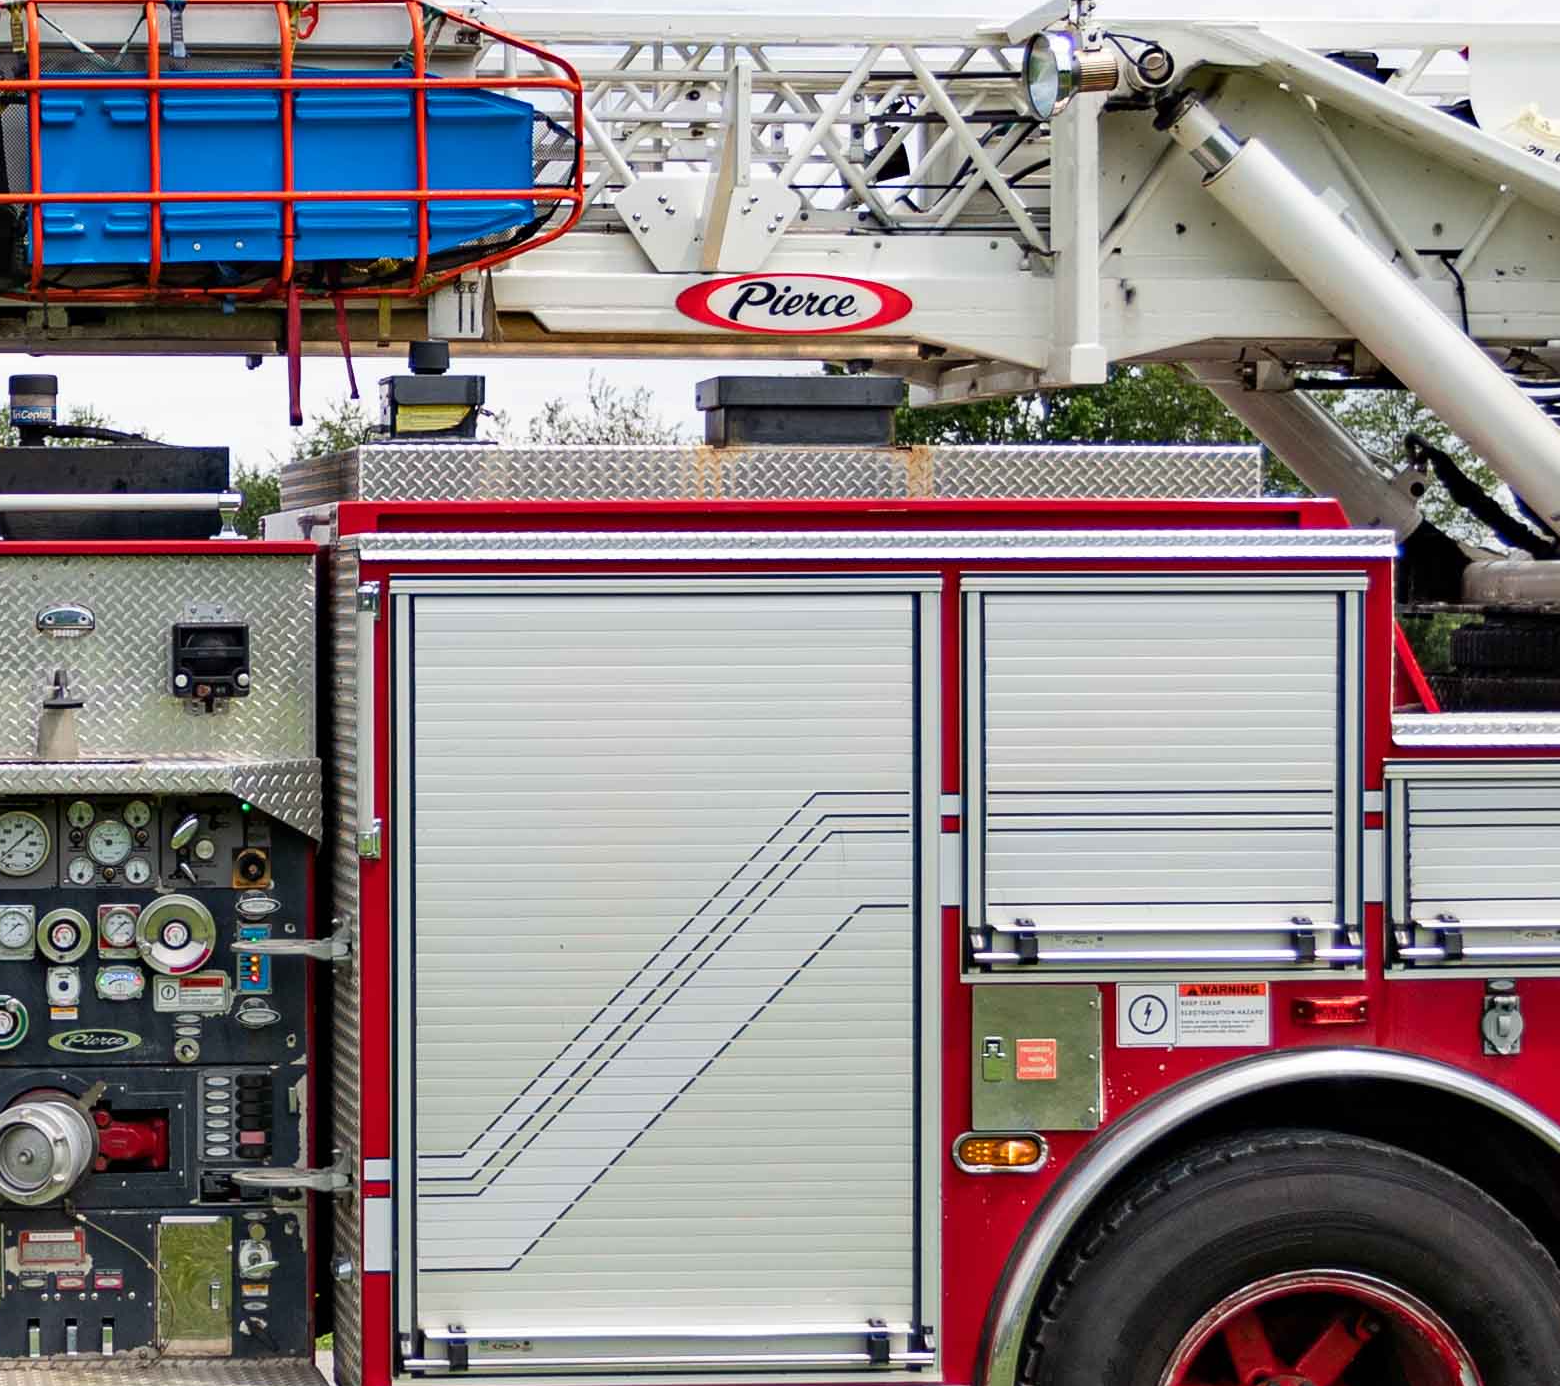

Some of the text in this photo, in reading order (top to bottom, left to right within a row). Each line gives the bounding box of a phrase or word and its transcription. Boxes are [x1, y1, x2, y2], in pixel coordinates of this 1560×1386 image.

[728, 281, 859, 321] Pierce
[1199, 984, 1260, 996] WARNING
[66, 1033, 127, 1046] Pierce
